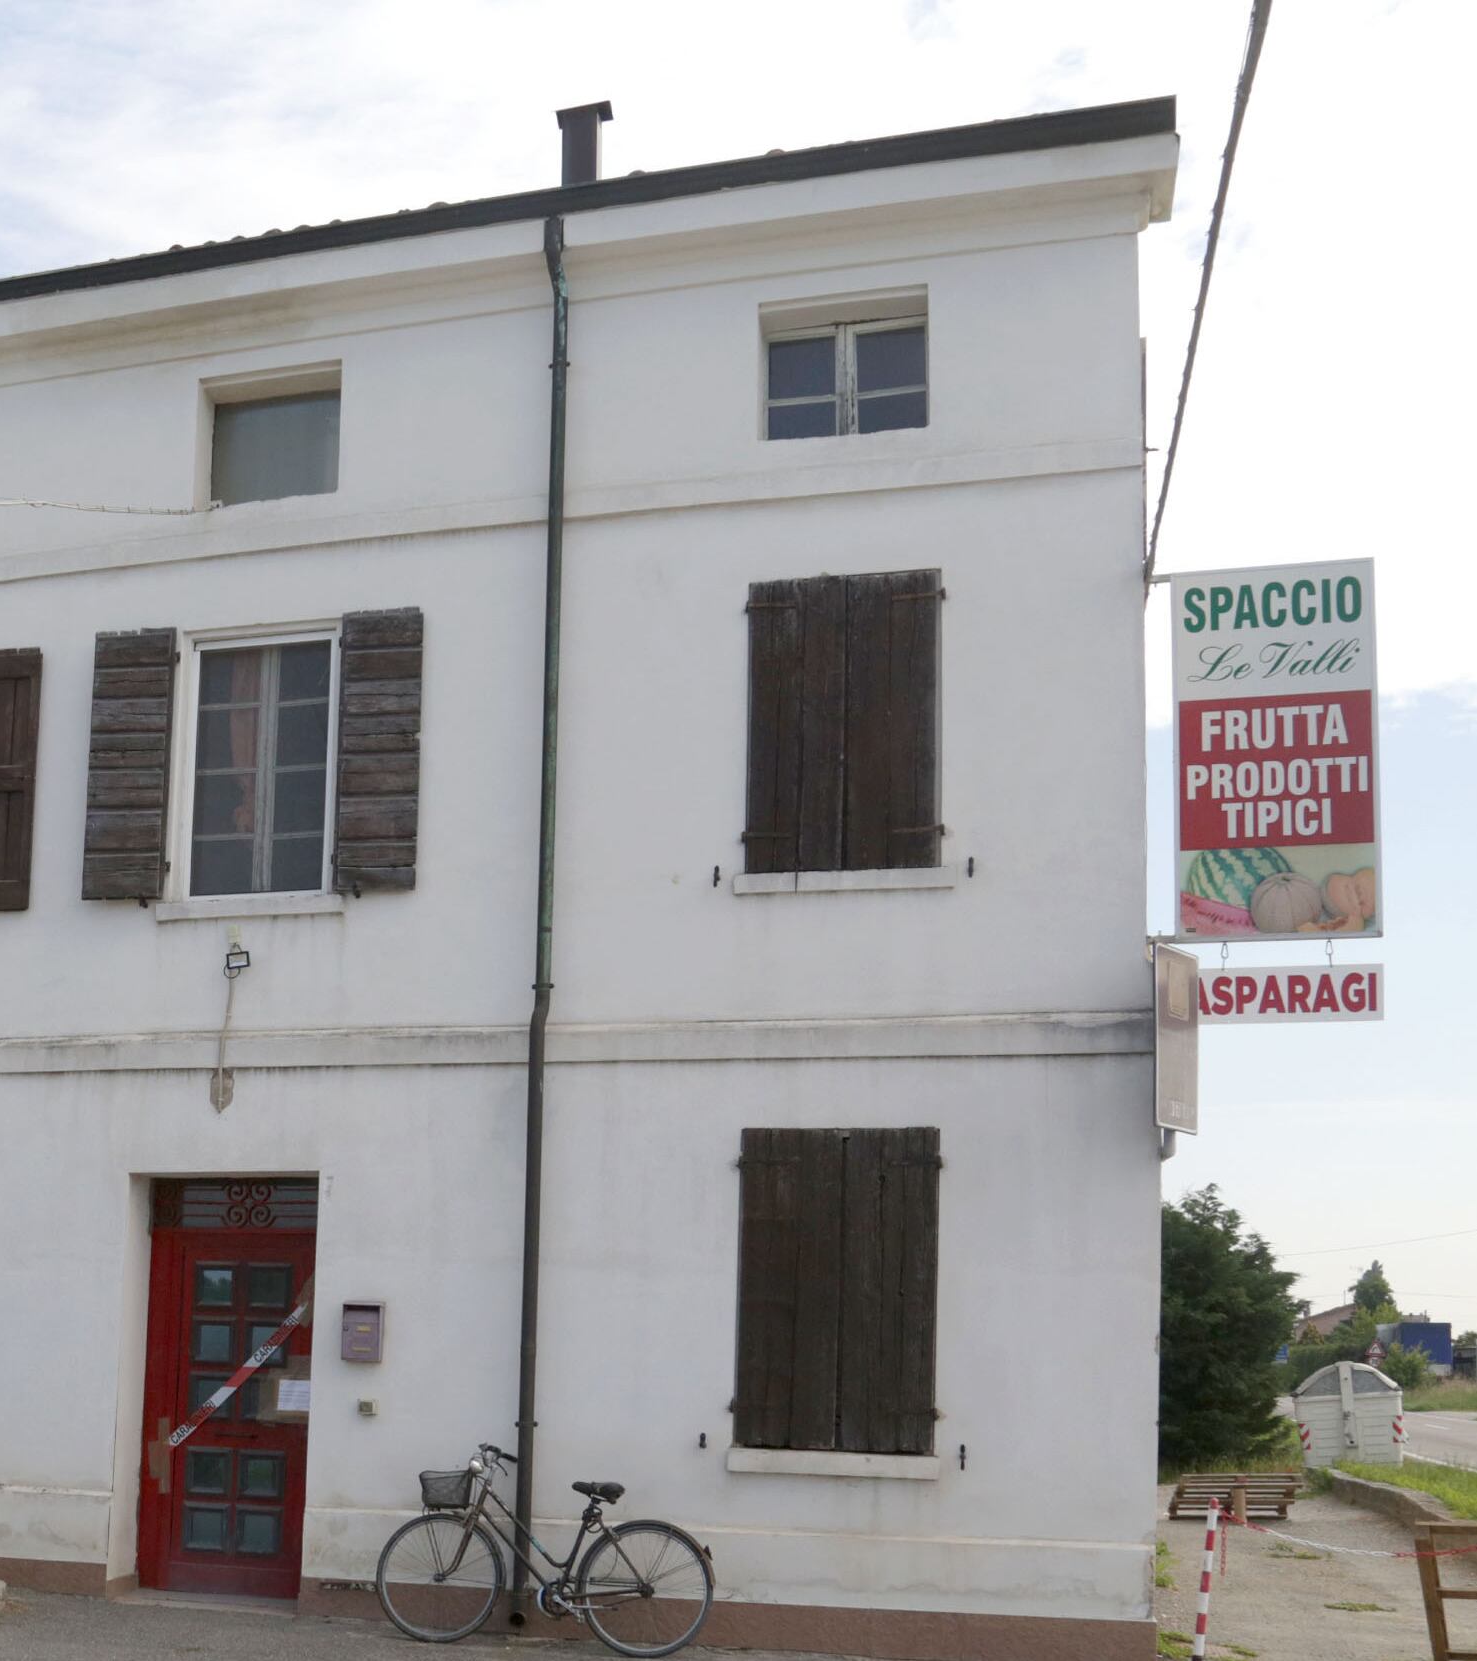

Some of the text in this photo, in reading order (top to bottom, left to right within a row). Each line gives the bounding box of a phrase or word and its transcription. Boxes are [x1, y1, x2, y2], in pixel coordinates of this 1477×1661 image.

[1183, 576, 1362, 633] SPACCIO
[1187, 637, 1360, 683] Le Valli
[1201, 704, 1348, 752] FRUTTA
[1186, 755, 1368, 801] PRODOTTI
[1221, 798, 1332, 839] TIPICI
